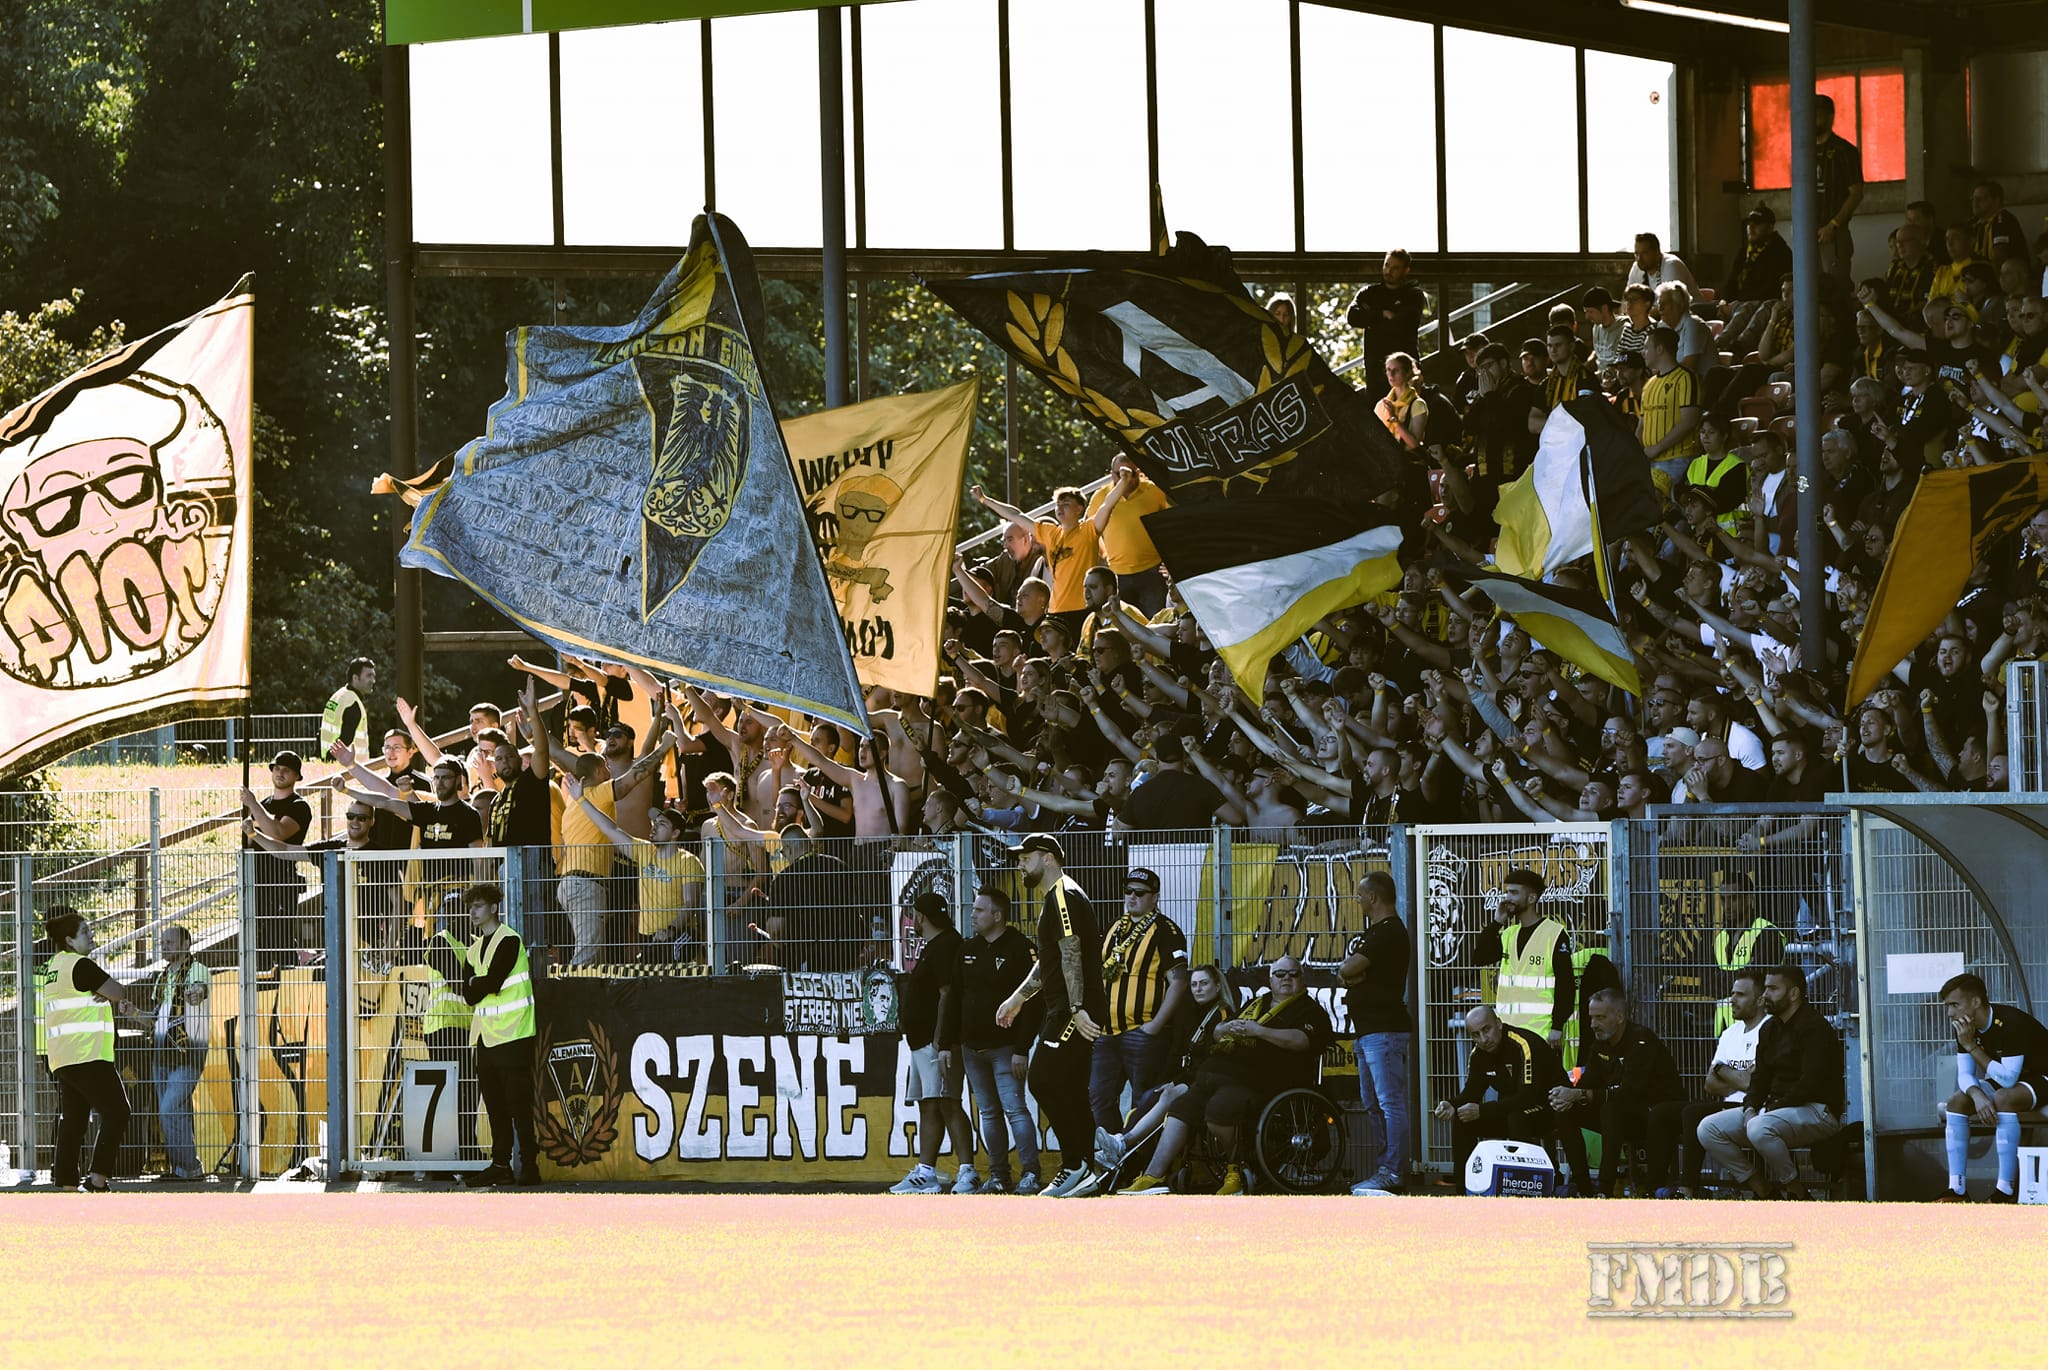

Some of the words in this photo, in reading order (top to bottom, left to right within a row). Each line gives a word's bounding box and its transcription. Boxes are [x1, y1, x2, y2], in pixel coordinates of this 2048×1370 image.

[1145, 383, 1307, 472] ULTRAS
[783, 971, 863, 1000] LEGENDEN
[784, 999, 839, 1028] STERBEN
[414, 1069, 447, 1153] 7
[630, 1031, 868, 1162] SZENE
